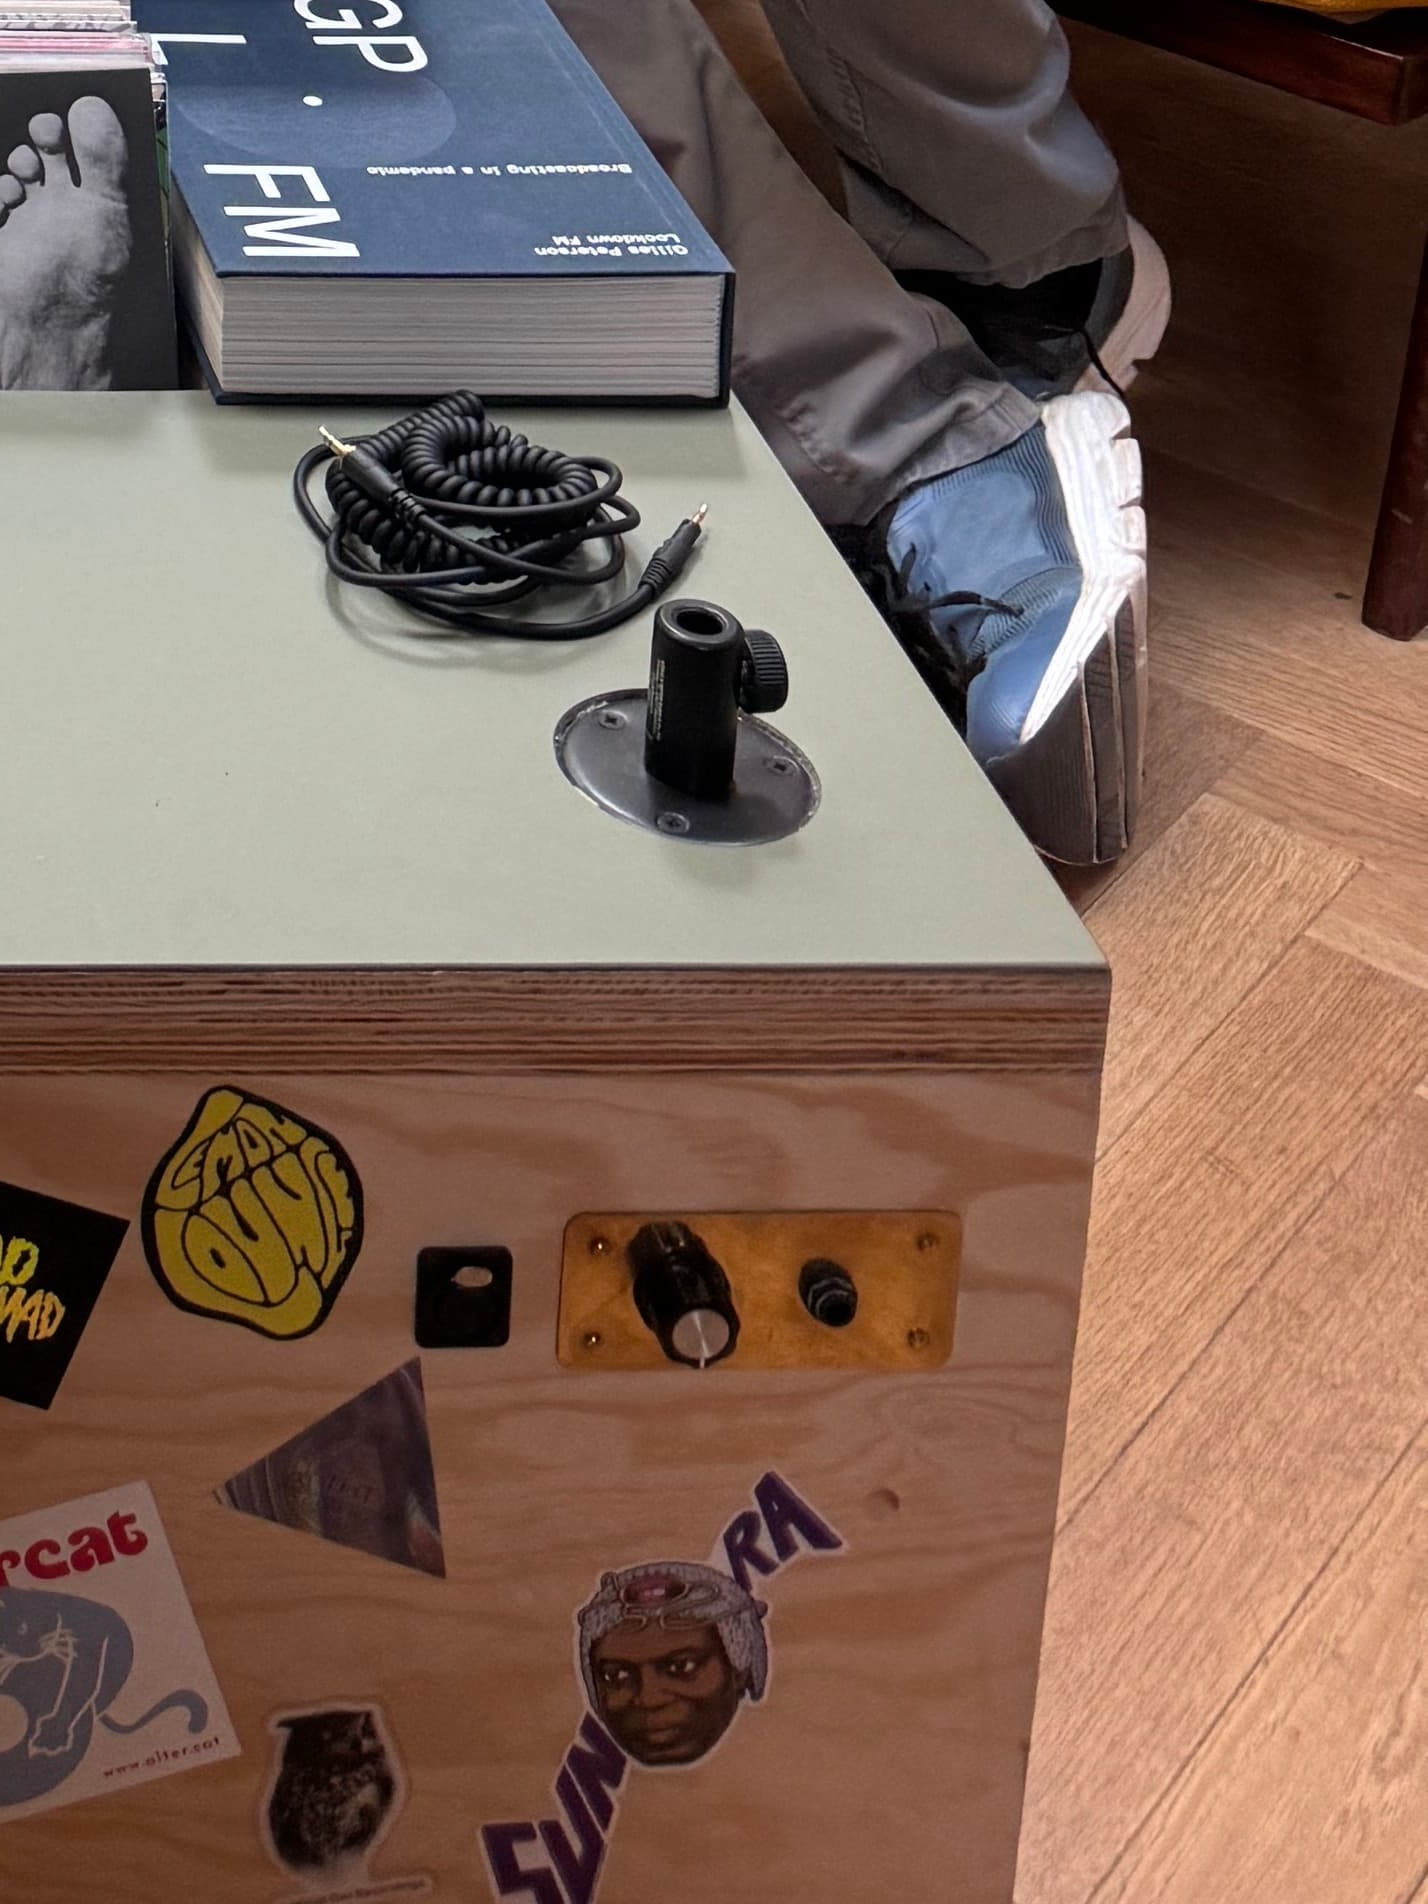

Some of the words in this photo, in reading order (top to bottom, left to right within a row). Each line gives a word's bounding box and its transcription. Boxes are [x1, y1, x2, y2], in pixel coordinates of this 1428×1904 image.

[366, 164, 457, 176] pandemic
[463, 166, 474, 175] a
[480, 165, 501, 176] in
[507, 164, 633, 176] Broadcasting
[203, 164, 360, 257] FM
[552, 234, 579, 246] FM
[586, 233, 682, 245] Lockdown
[534, 245, 622, 256] Peterson
[480, 1710, 629, 1904] SUN
[723, 1471, 844, 1592] RA
